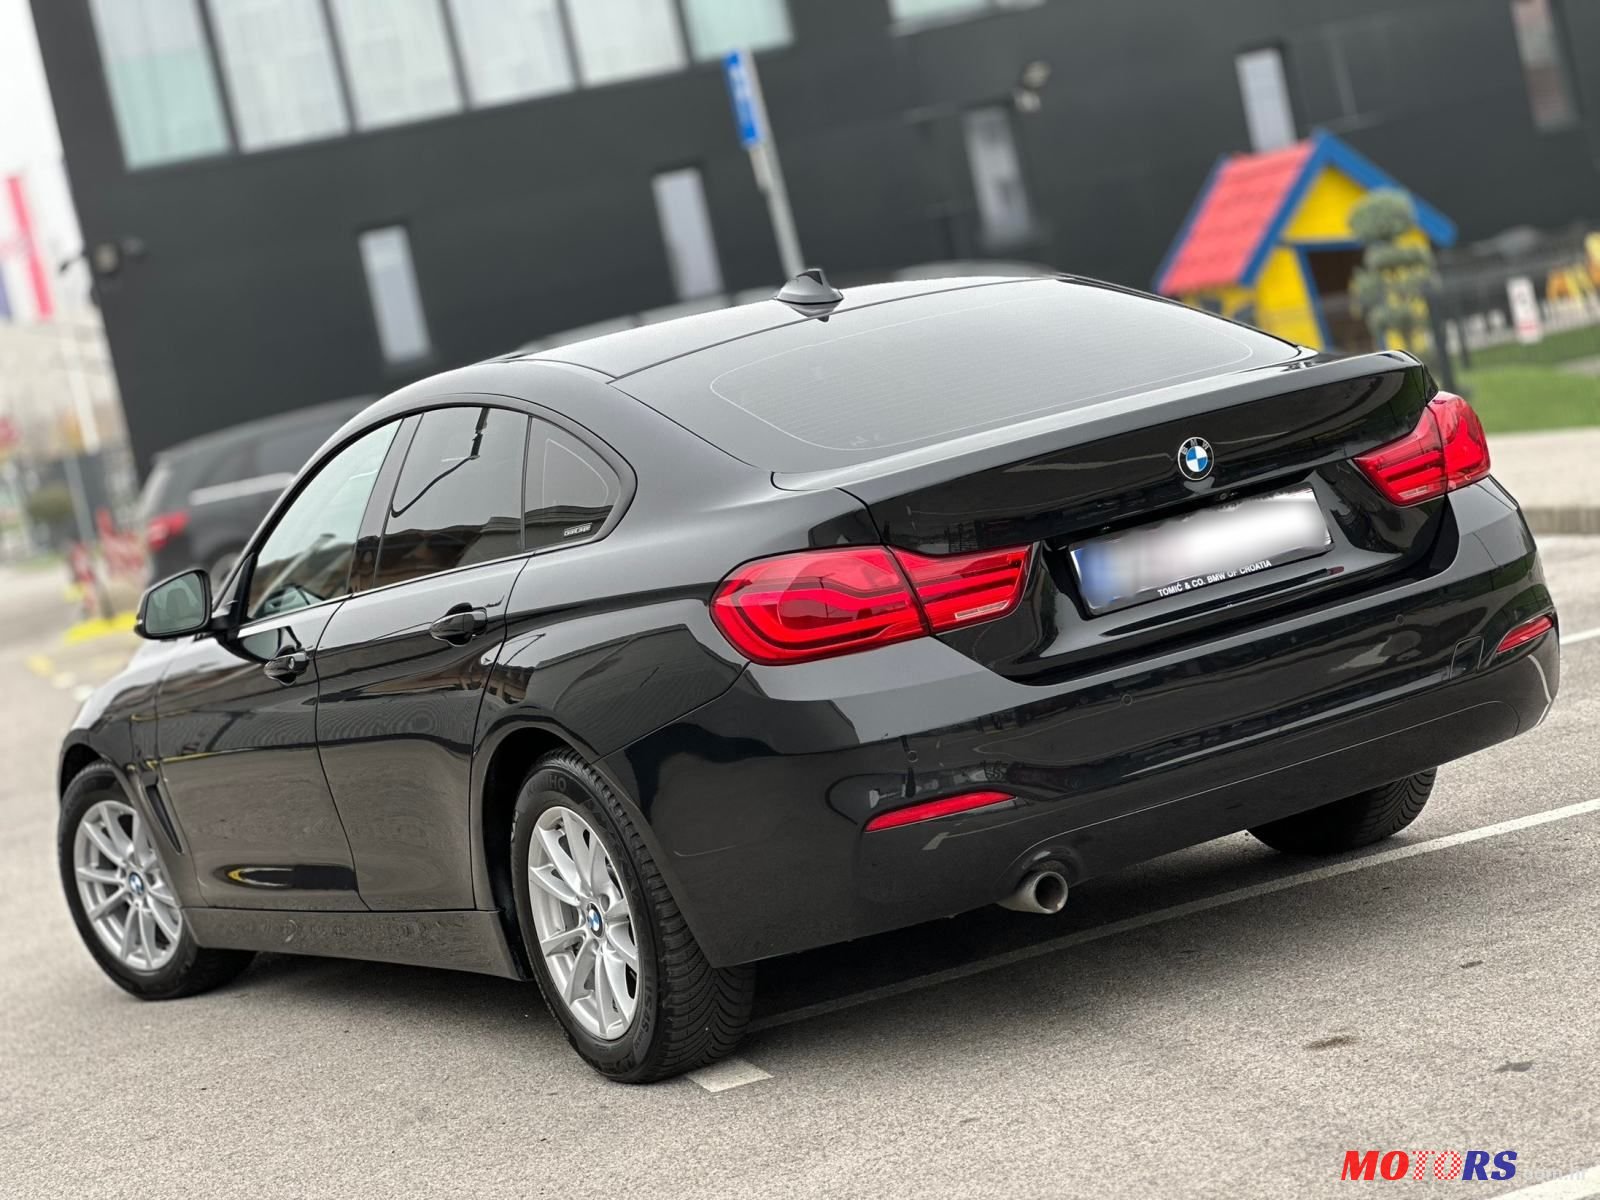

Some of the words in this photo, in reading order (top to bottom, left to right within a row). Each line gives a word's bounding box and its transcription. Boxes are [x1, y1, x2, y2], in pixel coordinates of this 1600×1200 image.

[1157, 583, 1183, 597] TOMIĆ
[1184, 582, 1191, 590] &
[1191, 578, 1205, 588] CO.
[1207, 573, 1226, 584] BMW
[1227, 570, 1238, 578] OF
[1239, 559, 1272, 575] CROATIA
